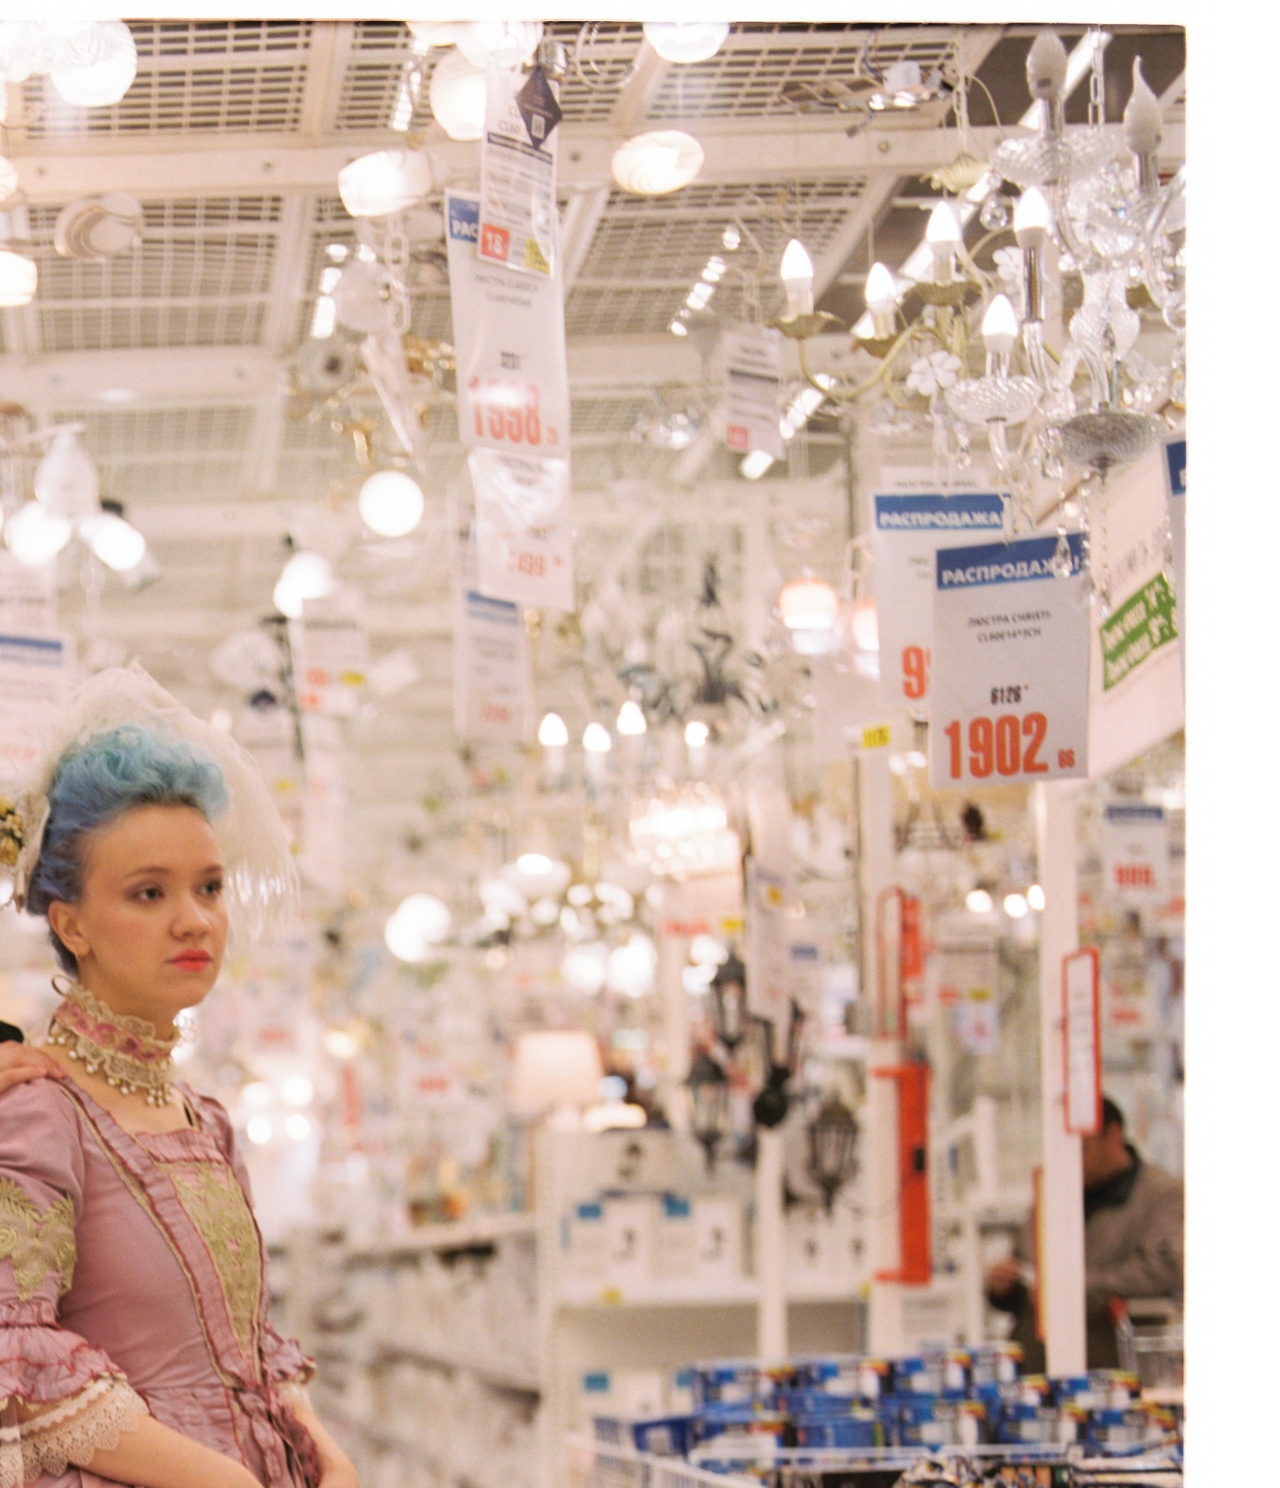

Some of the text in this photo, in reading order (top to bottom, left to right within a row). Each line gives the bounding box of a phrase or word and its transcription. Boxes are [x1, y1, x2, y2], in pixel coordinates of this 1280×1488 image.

[486, 229, 504, 255] 18
[878, 511, 1004, 528] РАСПРОДАЖА!
[942, 555, 1080, 587] РАСПРОДАЖ!
[944, 711, 1049, 780] 1902
